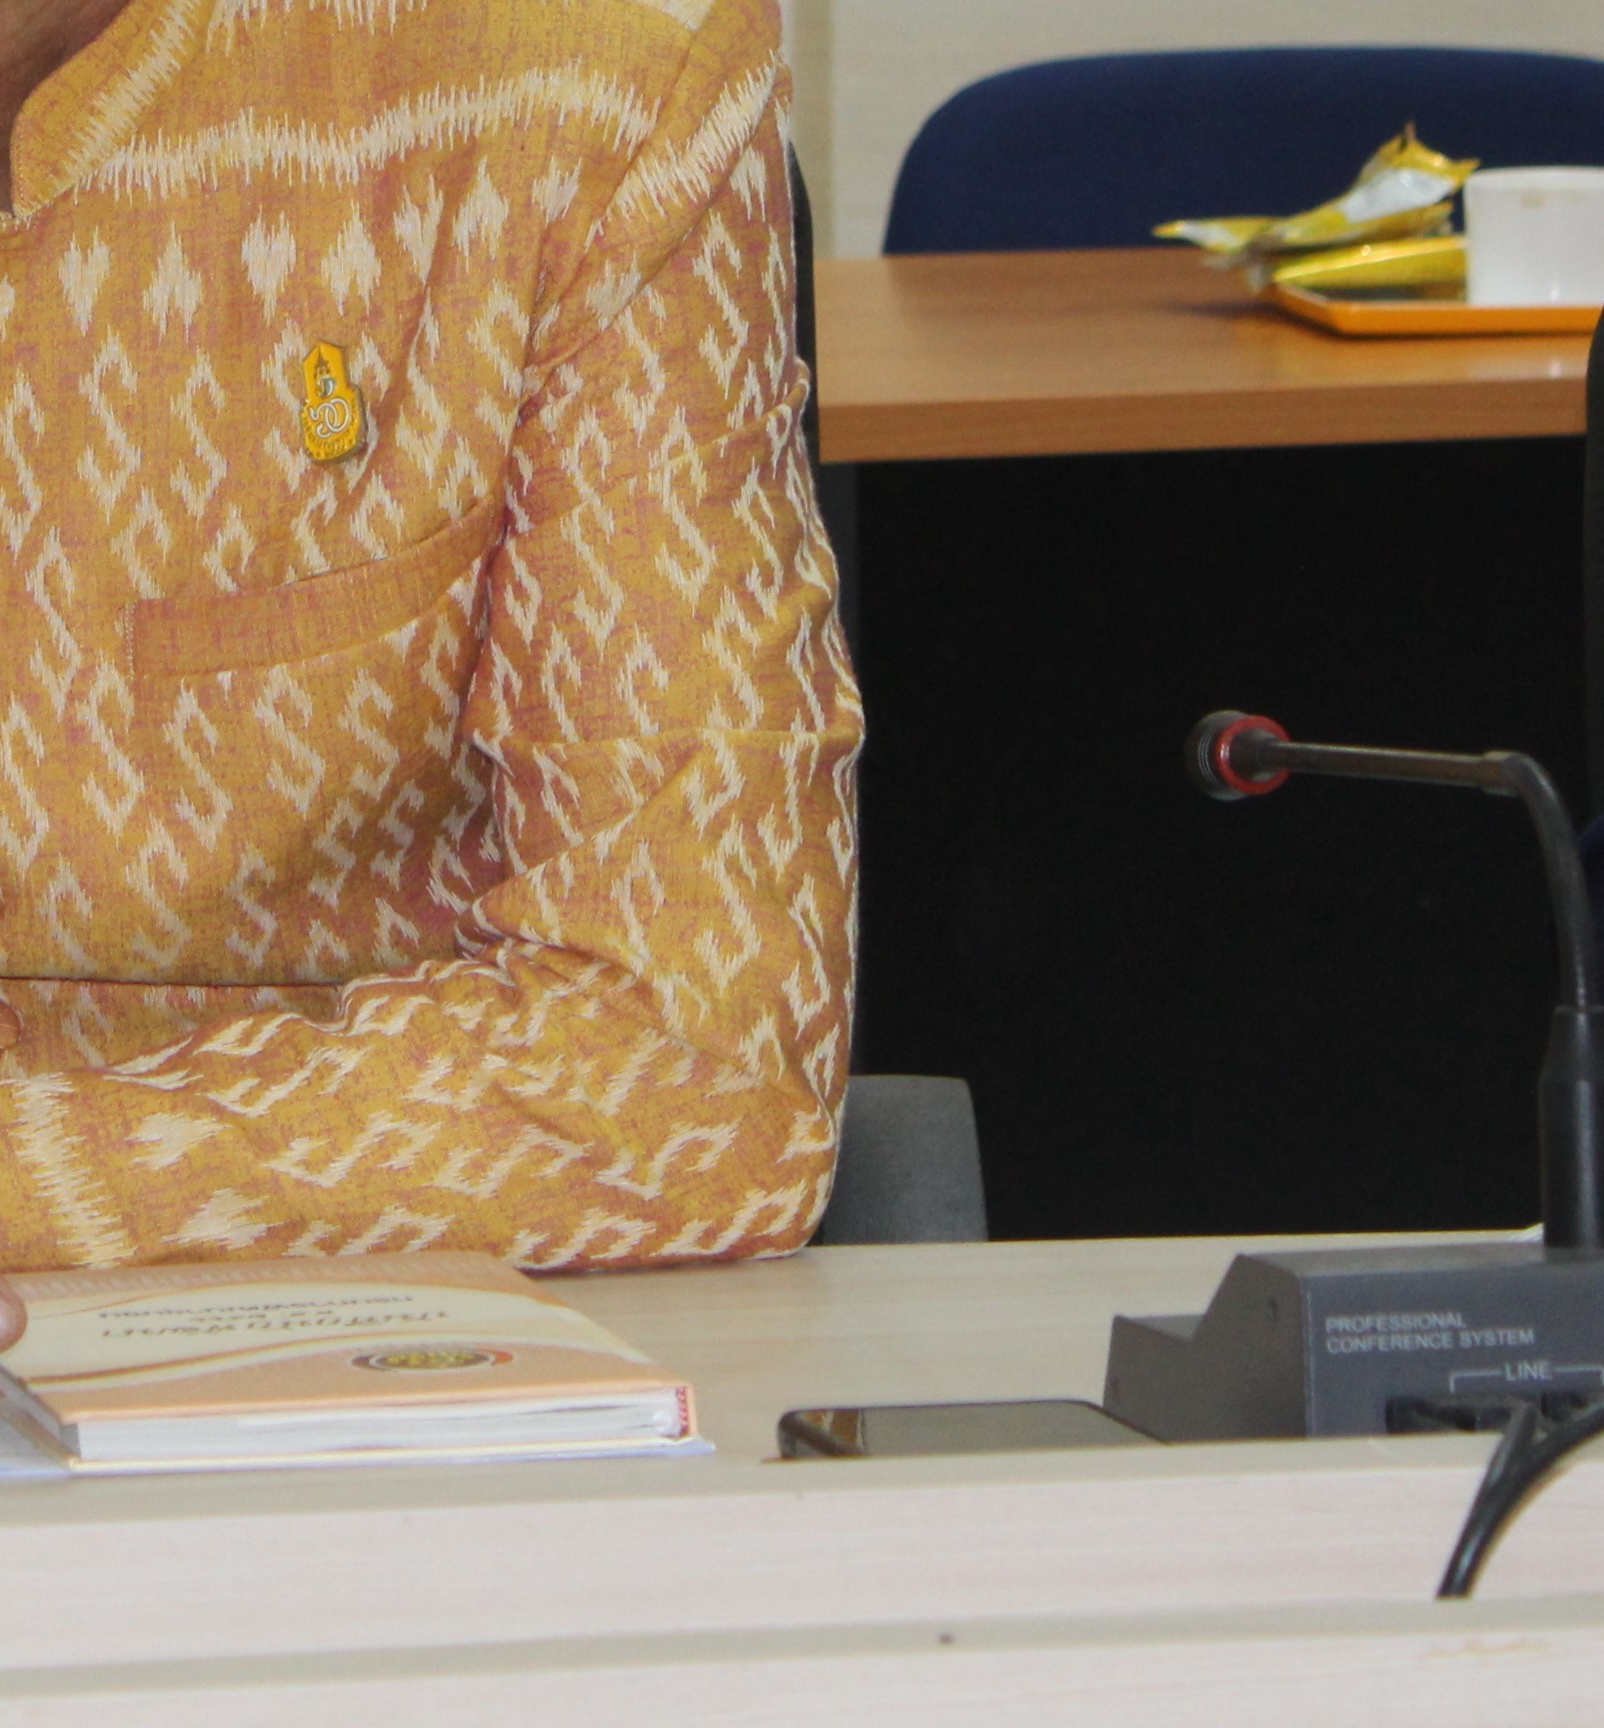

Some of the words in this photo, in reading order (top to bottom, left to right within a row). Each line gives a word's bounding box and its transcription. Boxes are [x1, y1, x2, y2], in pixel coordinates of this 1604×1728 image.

[1325, 1313, 1467, 1333] PROFESSIONAL
[1326, 1333, 1454, 1354] CONFERENCE
[1459, 1328, 1536, 1349] SYSTEM
[1505, 1360, 1553, 1381] LINE
